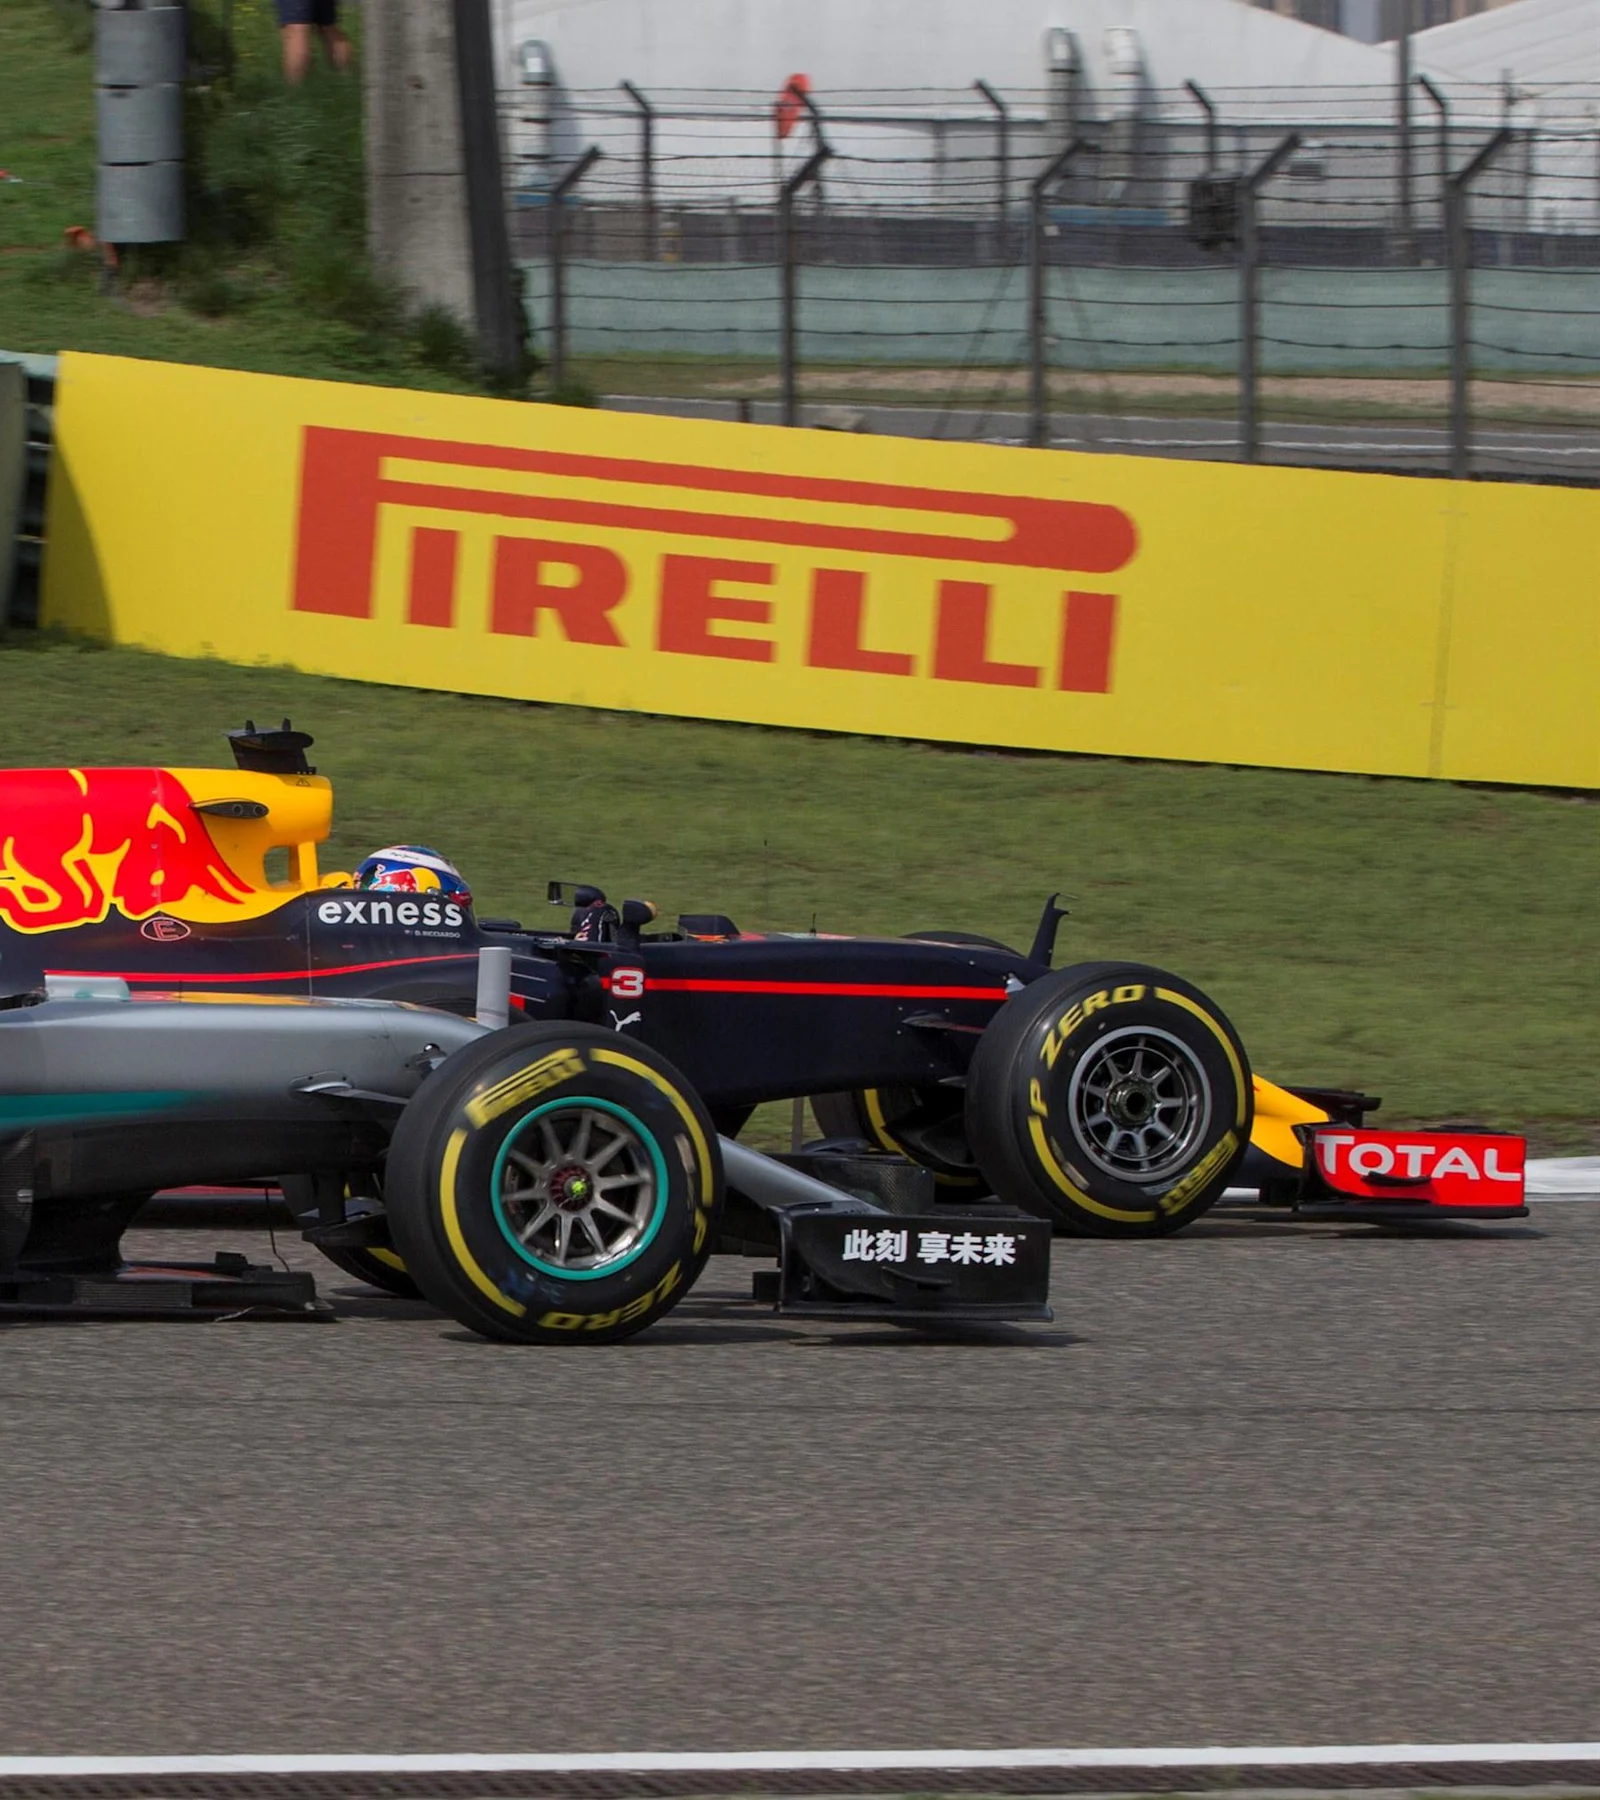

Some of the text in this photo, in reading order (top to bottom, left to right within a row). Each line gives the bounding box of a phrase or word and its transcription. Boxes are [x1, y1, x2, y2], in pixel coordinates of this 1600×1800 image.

[289, 425, 1140, 694] PIRELLI
[318, 900, 463, 927] exness
[610, 968, 645, 998] 3
[1039, 984, 1147, 1070] ZERO
[1315, 1134, 1522, 1182] TOTAL
[842, 1228, 1017, 1266] 此刻 享未来
[536, 1260, 683, 1331] ZERO
